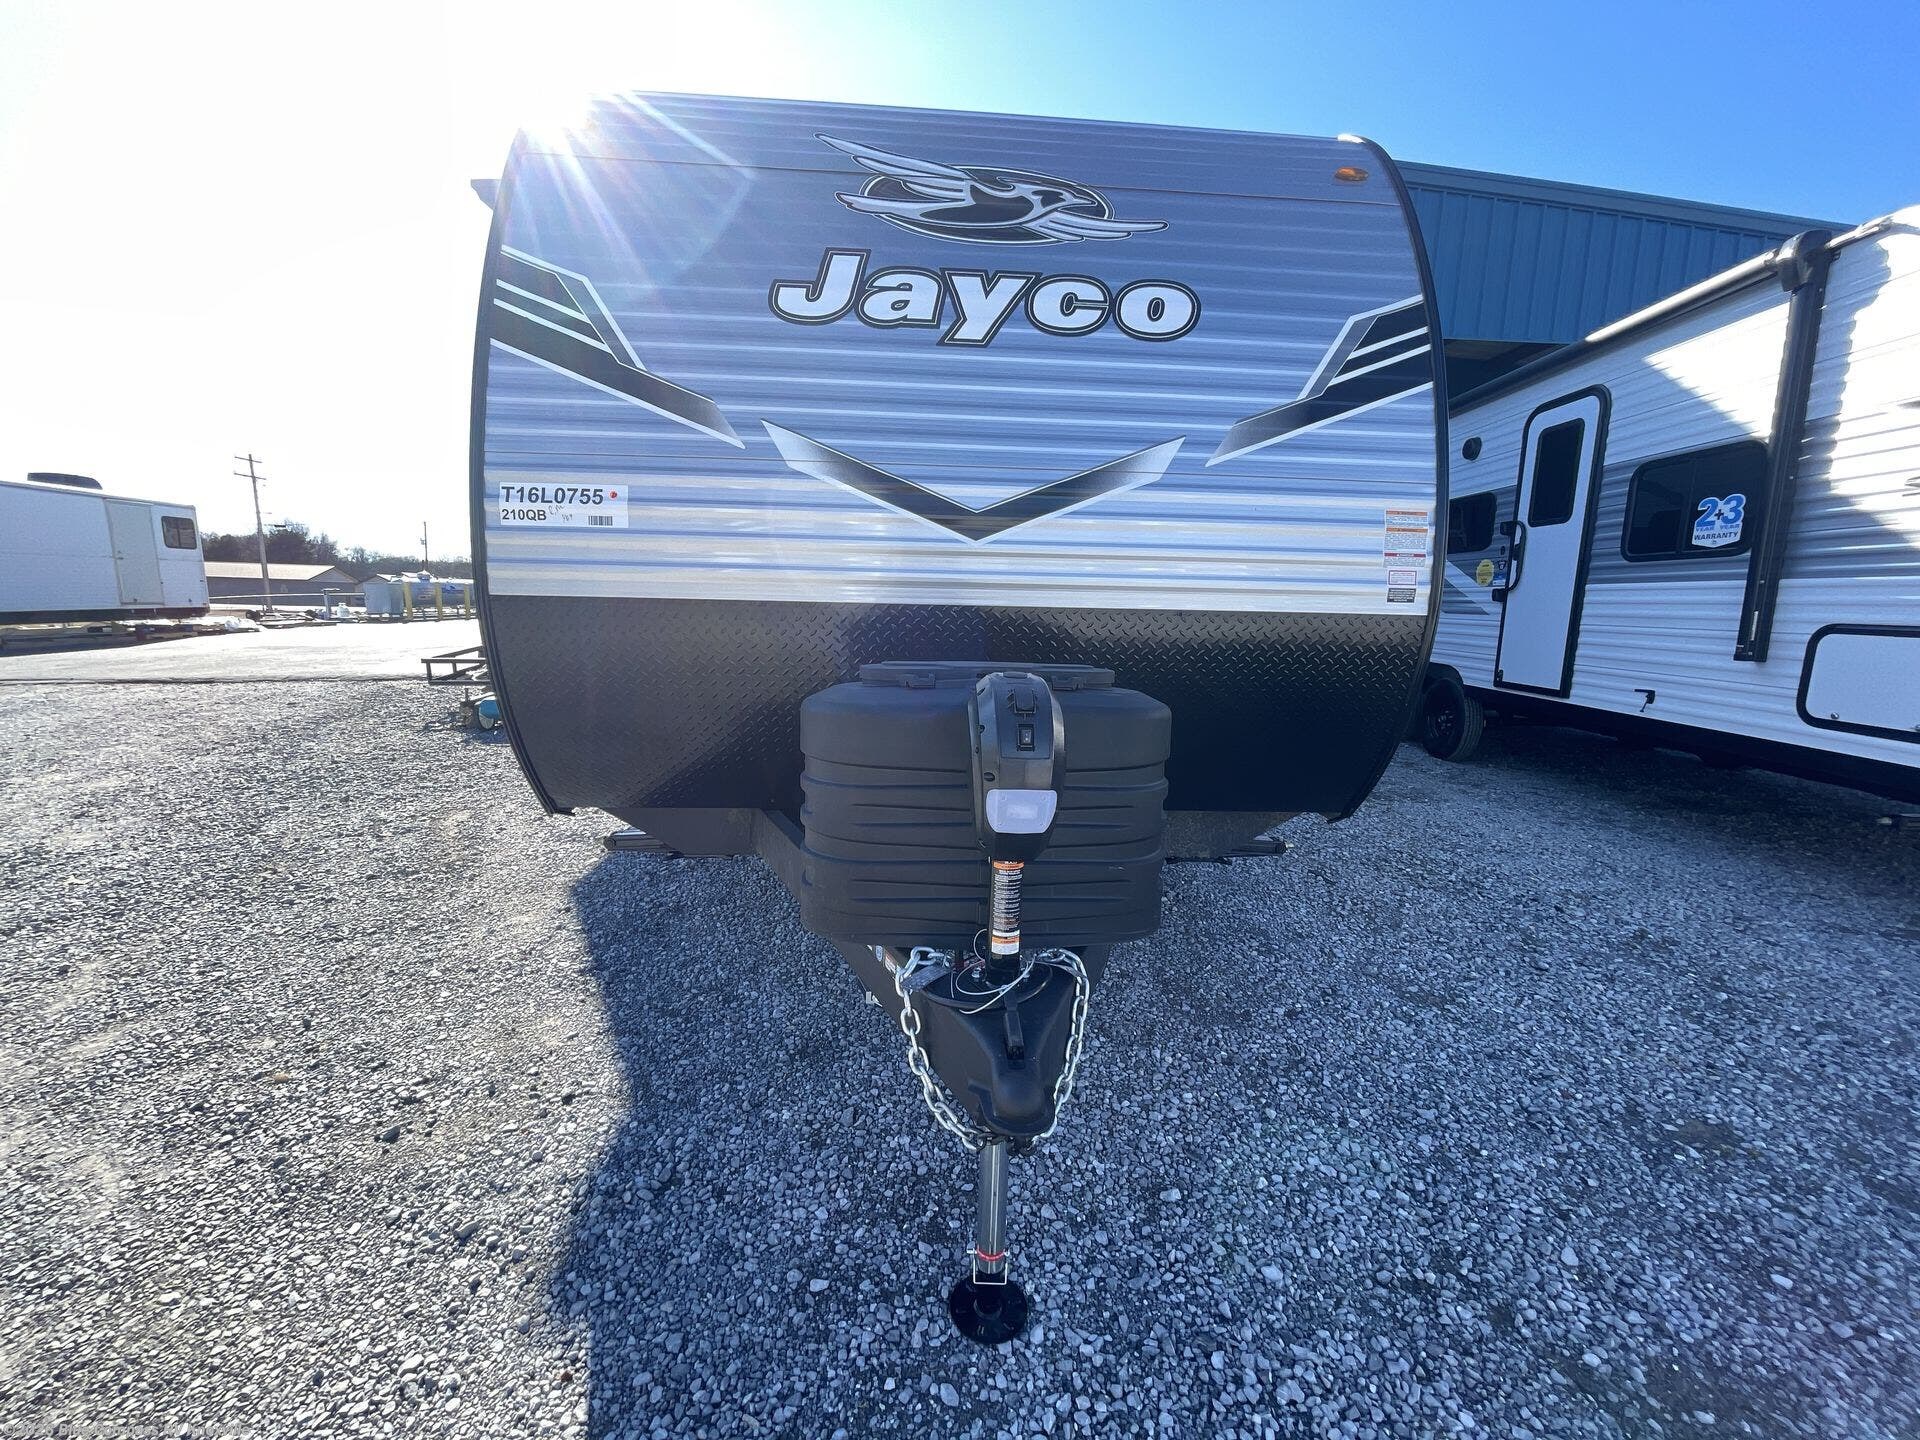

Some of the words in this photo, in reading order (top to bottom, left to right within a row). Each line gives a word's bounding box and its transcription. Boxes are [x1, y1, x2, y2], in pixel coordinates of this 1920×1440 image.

[769, 247, 1201, 347] Jayco
[501, 486, 604, 505] T16L0755
[502, 509, 547, 521] 210QB
[1694, 532, 1738, 540] WARRANTY
